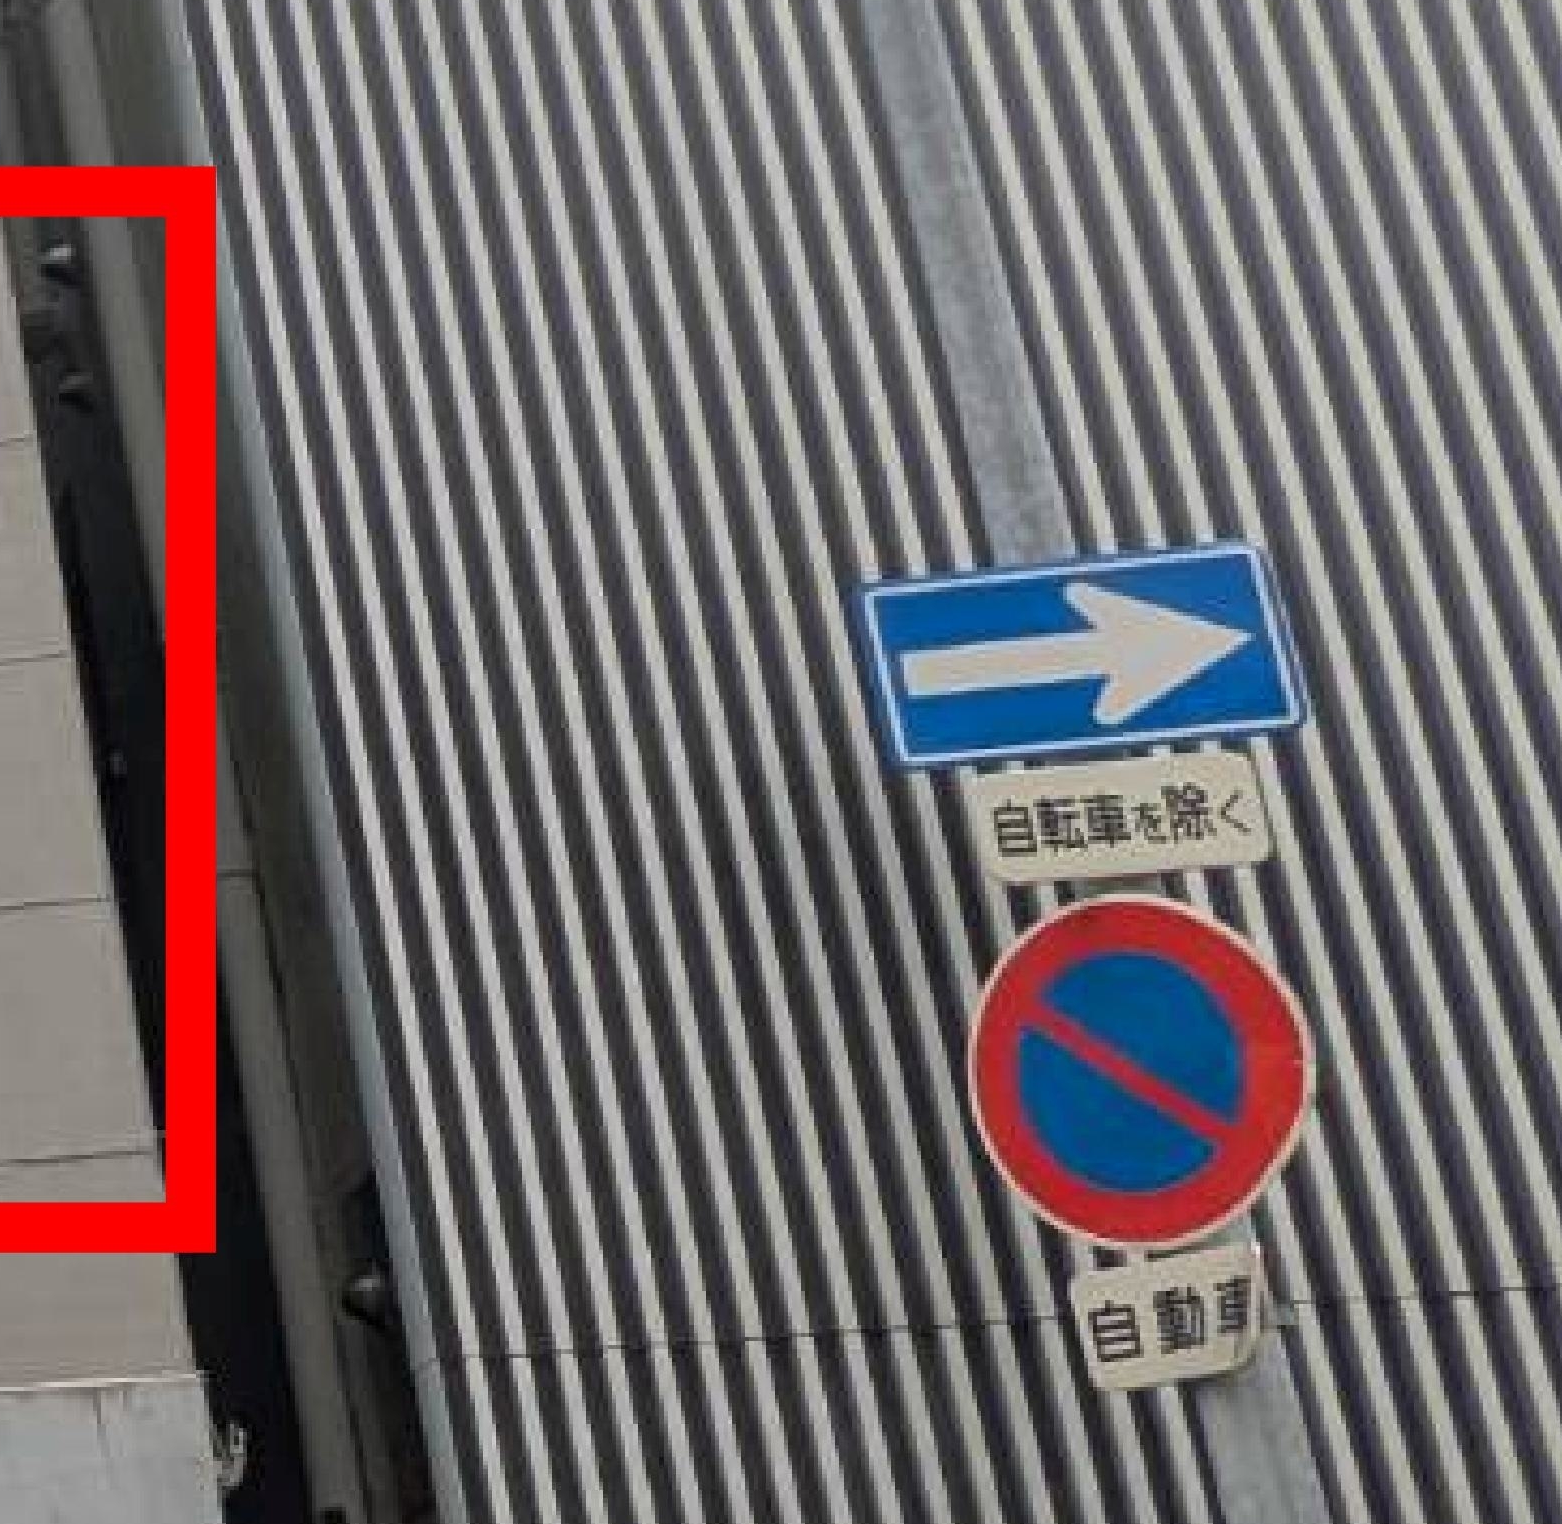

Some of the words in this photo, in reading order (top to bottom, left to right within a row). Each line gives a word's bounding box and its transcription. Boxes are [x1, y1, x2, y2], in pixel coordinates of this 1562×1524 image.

[991, 783, 1254, 858] 自転車を除く
